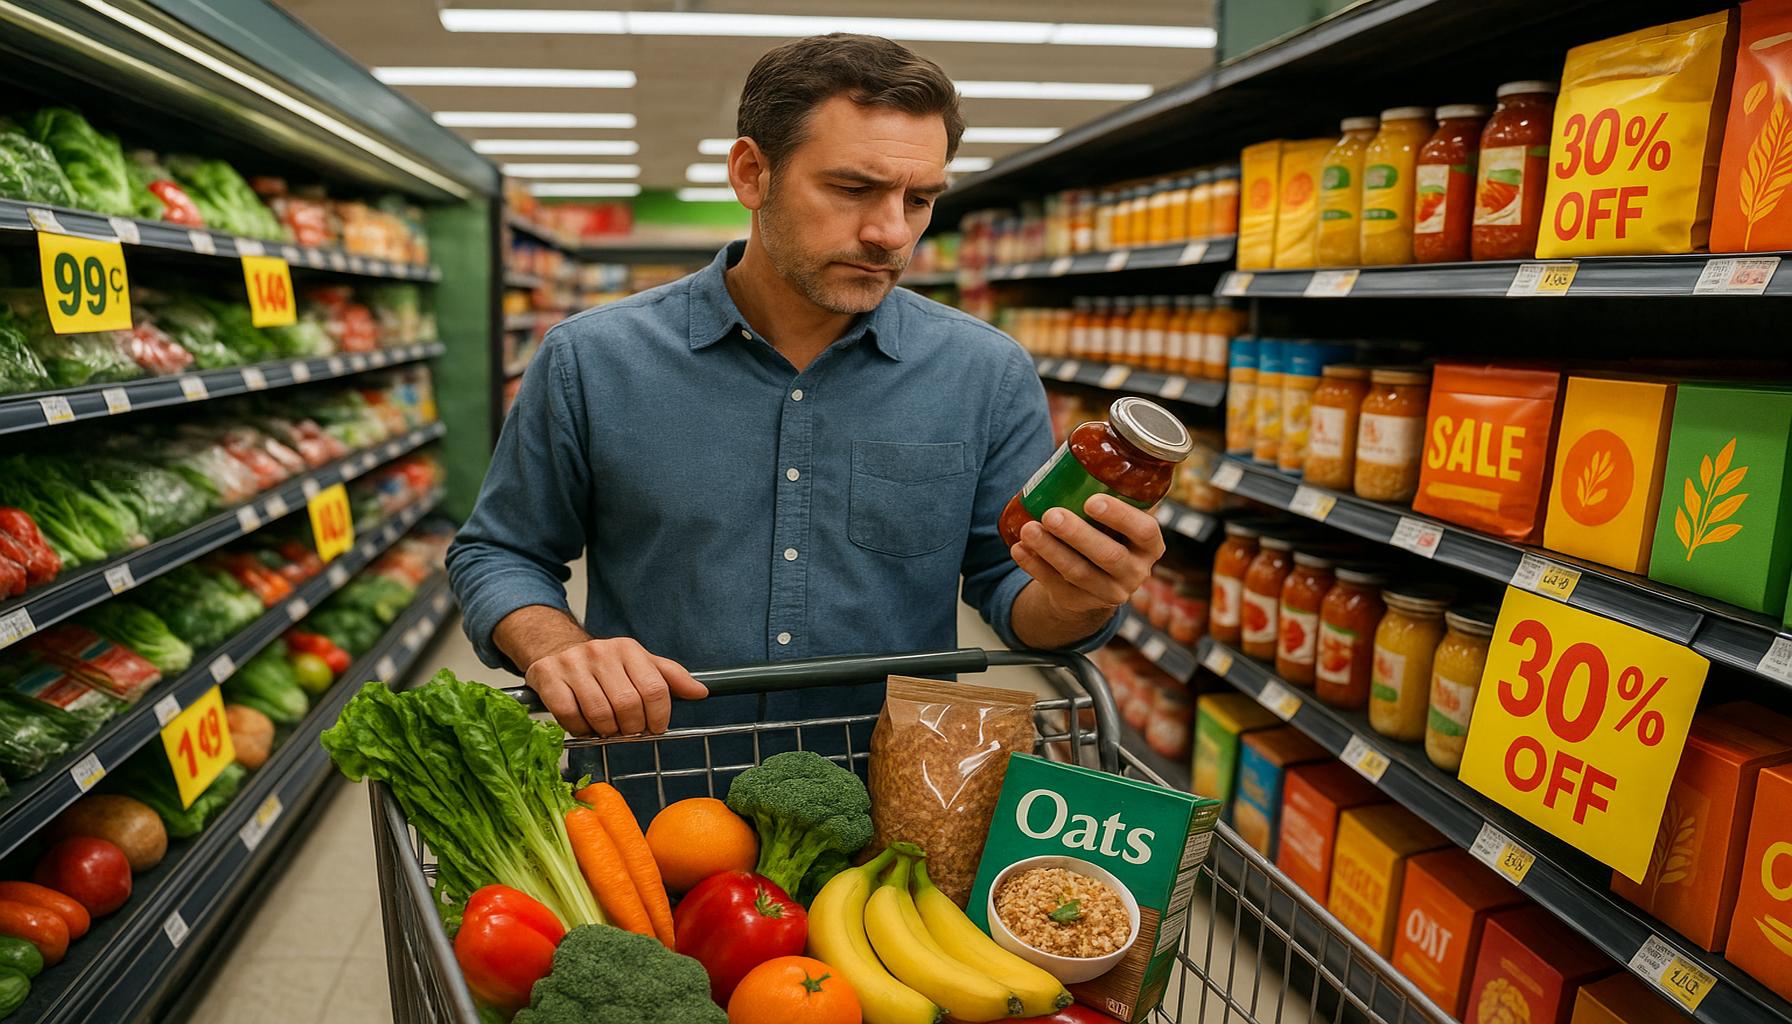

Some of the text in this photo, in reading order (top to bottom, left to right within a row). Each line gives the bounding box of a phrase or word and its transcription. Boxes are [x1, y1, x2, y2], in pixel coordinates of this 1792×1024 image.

[1555, 107, 1672, 180] 30%
[1554, 186, 1649, 242] OFF
[1427, 415, 1526, 482] SALE
[1496, 618, 1669, 745] 30%
[1503, 735, 1618, 826] OFF
[1015, 788, 1156, 866] Oats
